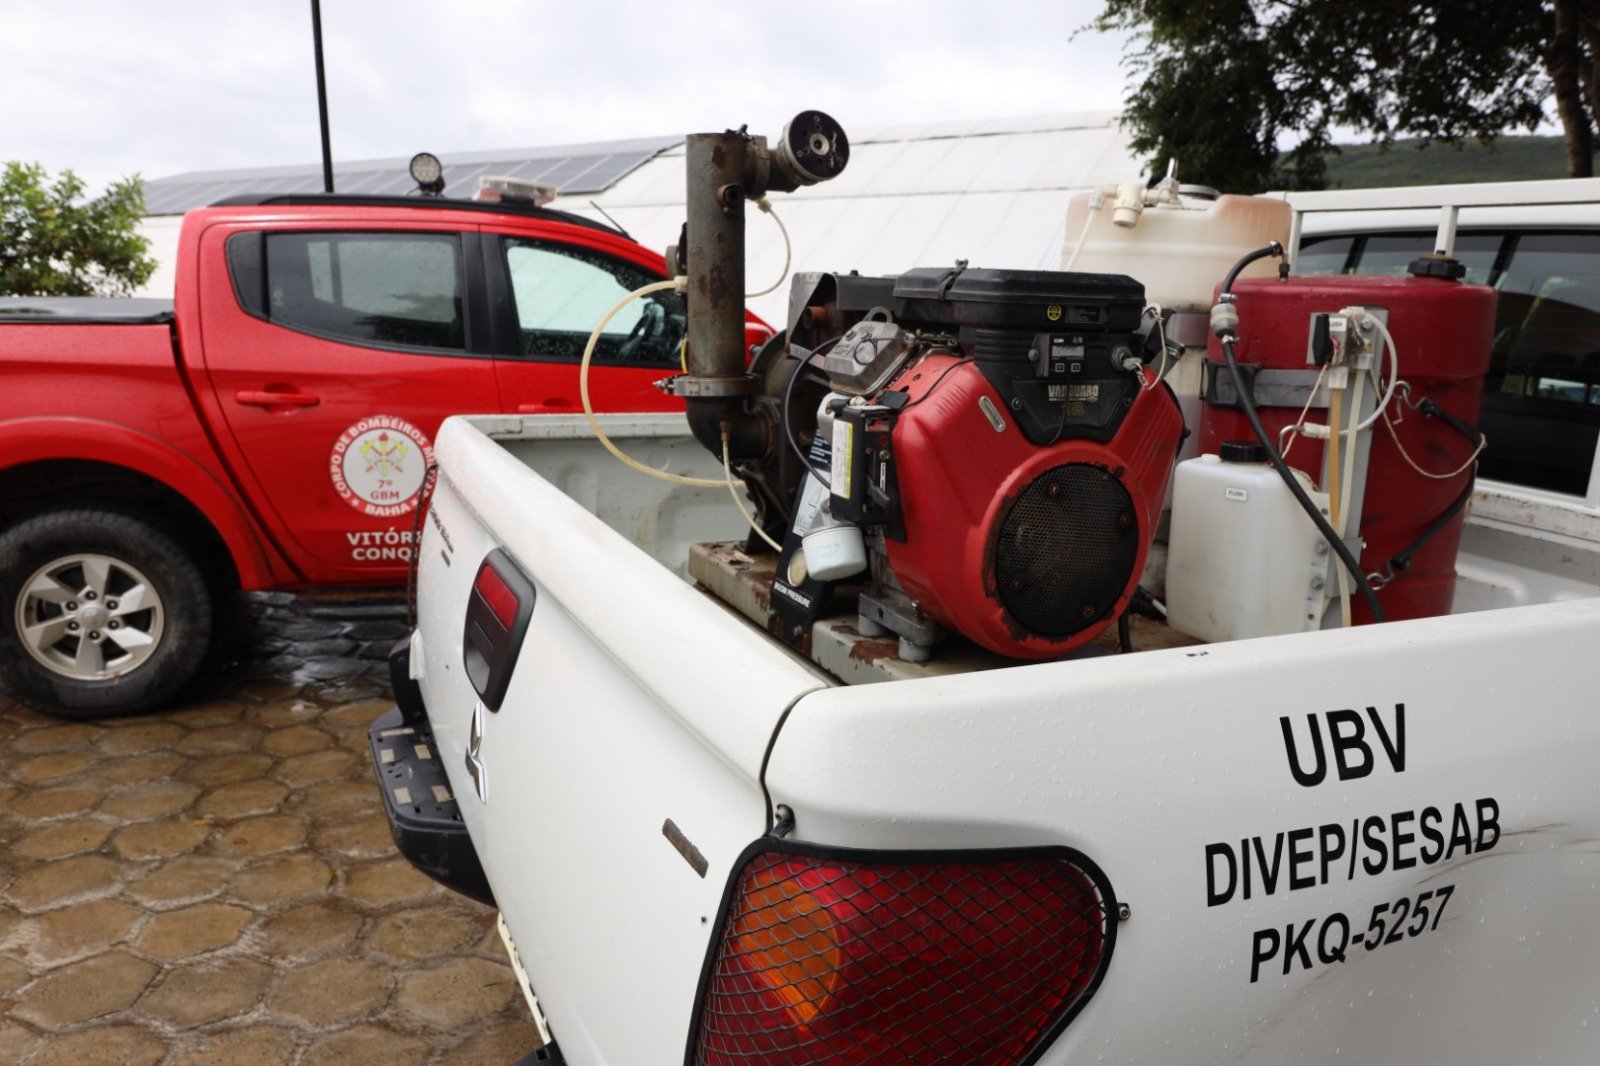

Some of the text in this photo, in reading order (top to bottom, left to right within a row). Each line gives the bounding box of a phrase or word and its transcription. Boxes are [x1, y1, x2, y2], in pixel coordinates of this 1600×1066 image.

[334, 431, 351, 453] DE
[330, 454, 352, 499] CORPO
[370, 491, 399, 500] GBM
[364, 503, 412, 517] BAHIA
[1279, 703, 1406, 788] UBV
[1205, 797, 1501, 907] DIVEP/SESAB
[1250, 885, 1456, 984] PKQ-5257
